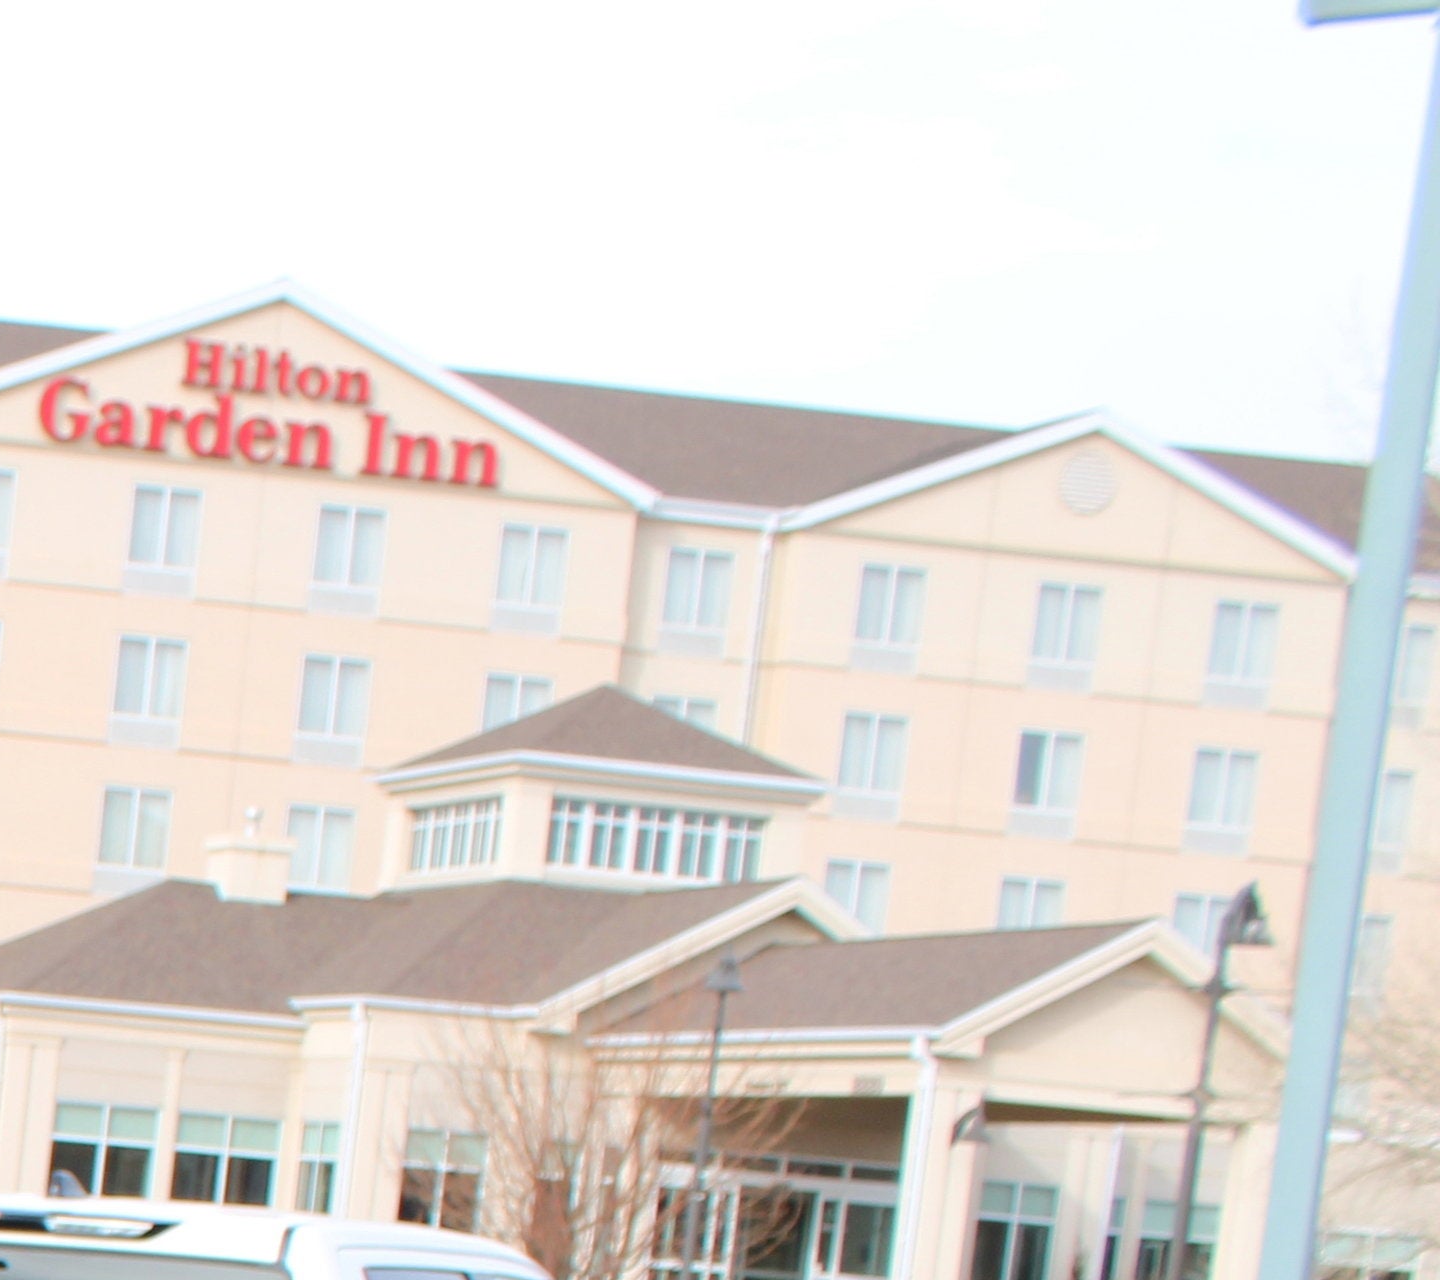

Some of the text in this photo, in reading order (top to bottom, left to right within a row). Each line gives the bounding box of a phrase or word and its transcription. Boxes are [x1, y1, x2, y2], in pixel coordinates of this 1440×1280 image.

[182, 338, 371, 404] Hilton
[40, 376, 499, 487] Garden Inn
